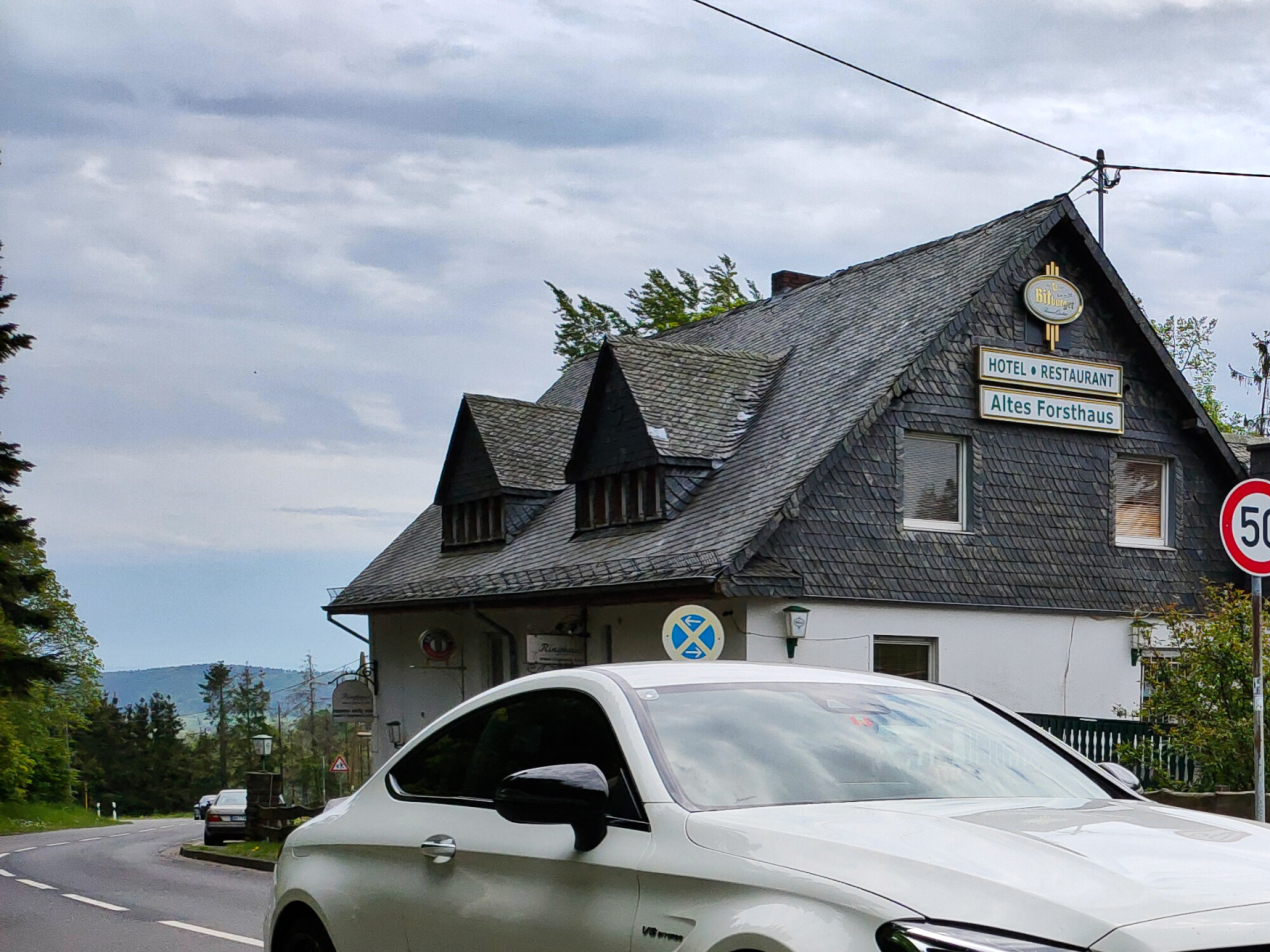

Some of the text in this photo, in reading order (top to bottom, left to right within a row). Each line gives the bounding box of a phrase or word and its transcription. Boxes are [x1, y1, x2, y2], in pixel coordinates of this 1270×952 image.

[1036, 287, 1074, 310] Bitburger
[989, 358, 1114, 387] HOTEL RESTAURANT
[991, 394, 1113, 424] Altes Forsthaus
